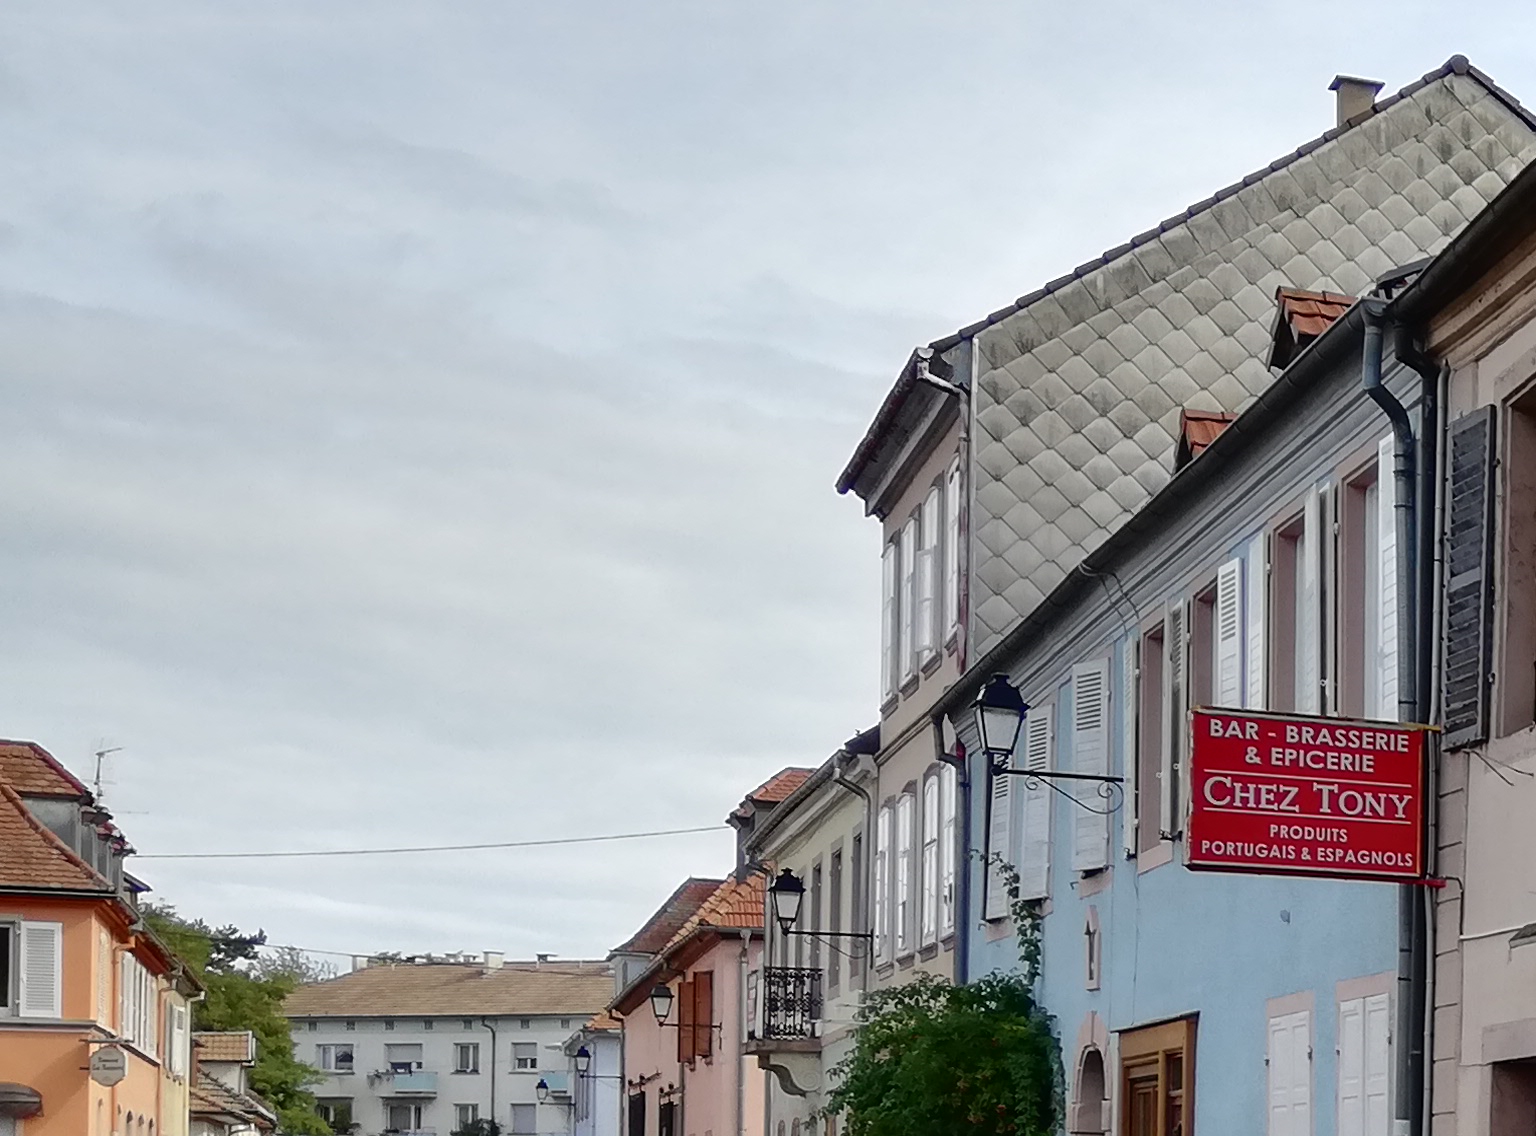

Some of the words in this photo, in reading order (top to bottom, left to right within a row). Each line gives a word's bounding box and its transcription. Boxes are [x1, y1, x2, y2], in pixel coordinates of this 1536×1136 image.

[1210, 718, 1259, 740] BAR
[1286, 725, 1410, 752] BRASSERIE
[1245, 746, 1262, 765] &
[1270, 747, 1375, 773] EPICERIE
[1203, 776, 1299, 813] CHEZ
[1313, 782, 1413, 818] TONY
[1269, 824, 1348, 843] PRODUITS
[1201, 840, 1296, 860] PORTUGAIS
[1301, 847, 1312, 861] &
[1317, 848, 1413, 867] ESPAGNOLS
